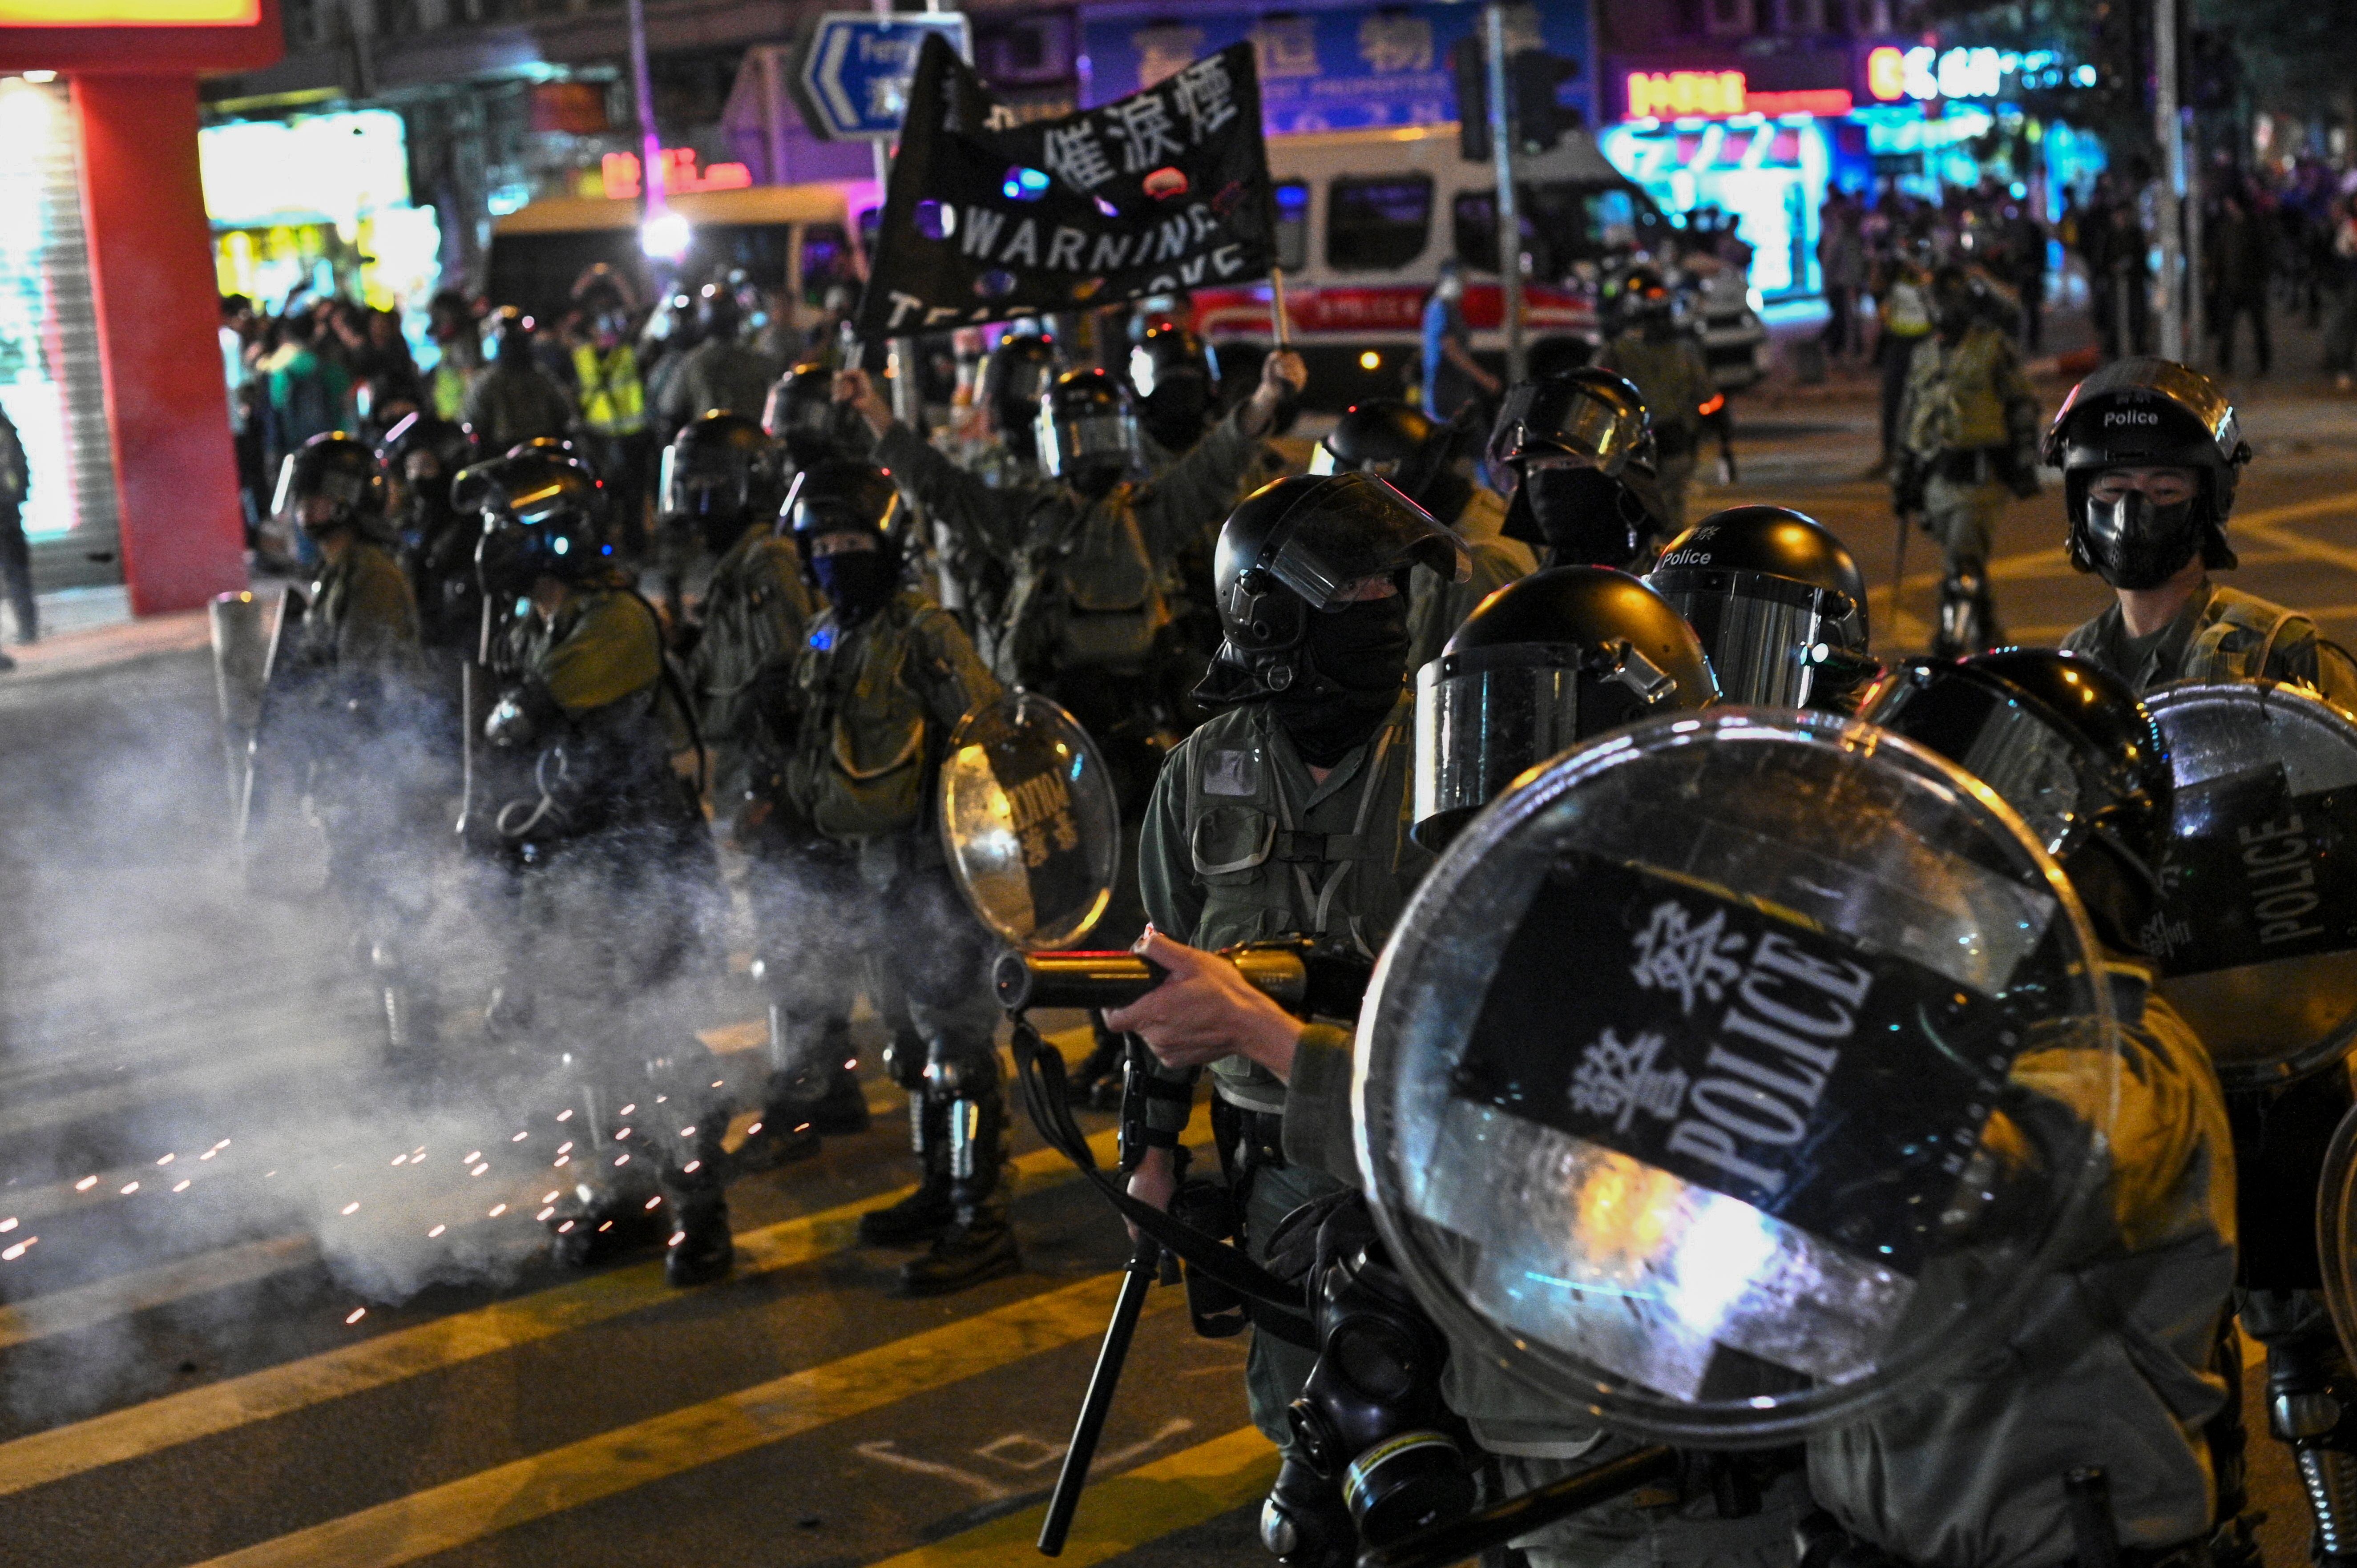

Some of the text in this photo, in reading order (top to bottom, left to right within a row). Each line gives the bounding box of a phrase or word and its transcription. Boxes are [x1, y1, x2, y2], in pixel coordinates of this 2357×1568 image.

[1043, 54, 1239, 193] 催淚煙
[2104, 408, 2159, 428] Police
[1661, 548, 1712, 568] Police
[2237, 814, 2326, 944] POLICE
[1569, 900, 1748, 1134] 警察
[1667, 931, 1873, 1196] POLICE
